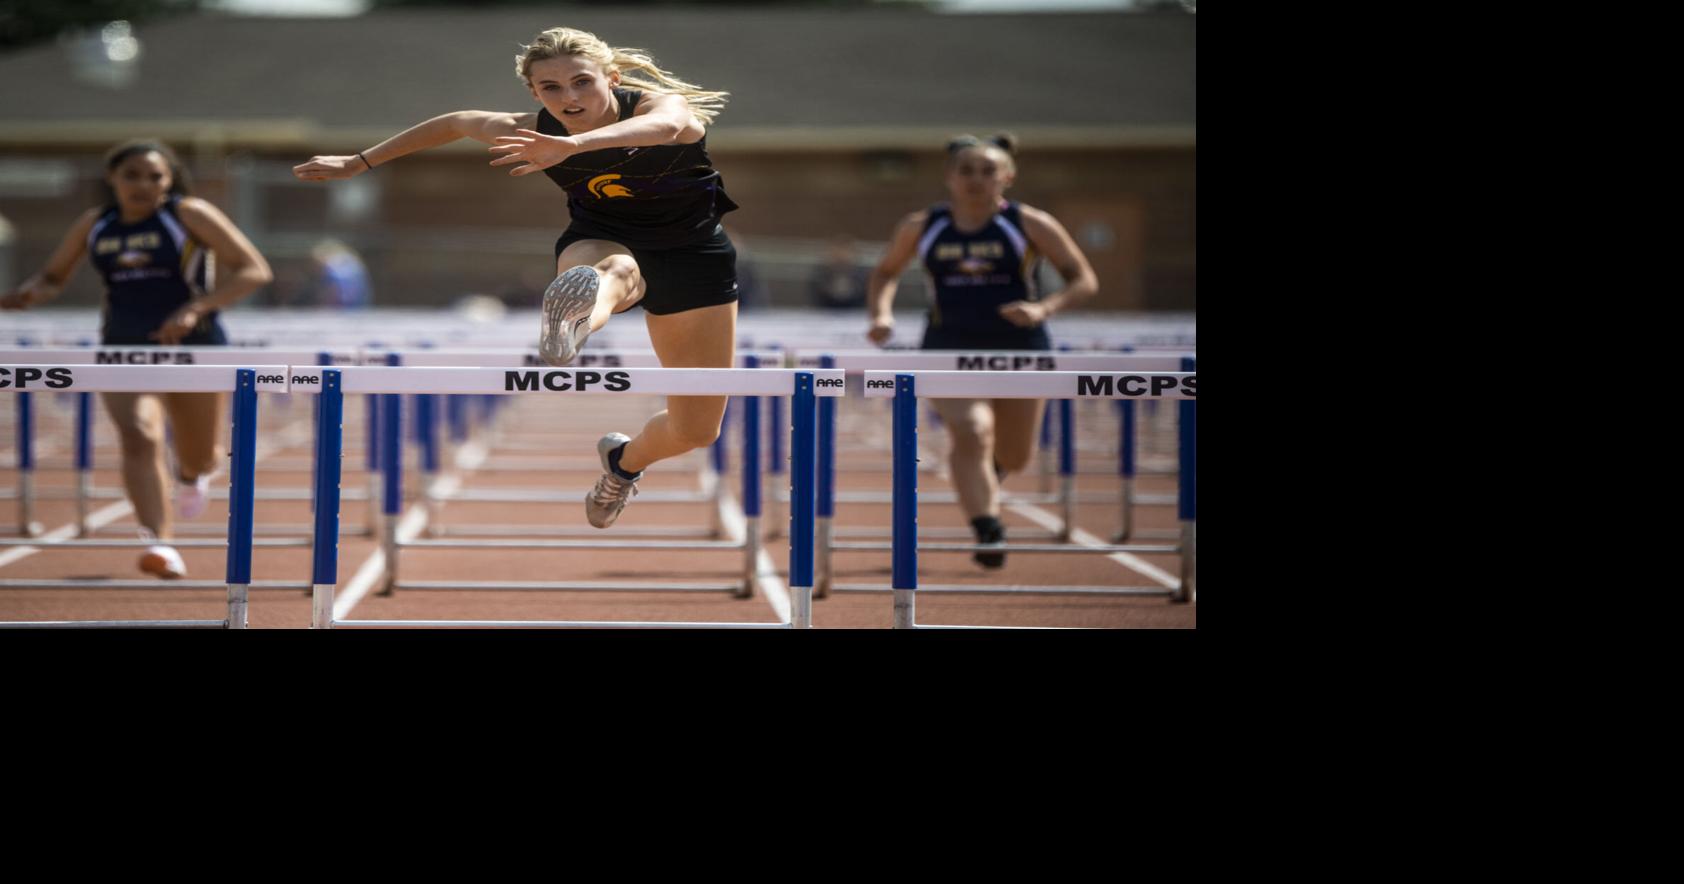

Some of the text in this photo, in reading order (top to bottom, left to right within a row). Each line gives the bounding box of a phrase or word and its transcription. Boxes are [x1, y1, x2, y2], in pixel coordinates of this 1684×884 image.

[96, 351, 195, 365] MCPS
[524, 354, 621, 367] MPS
[957, 356, 1057, 371] MCPS
[505, 371, 631, 391] MCPS
[1077, 375, 1196, 396] MCPS
